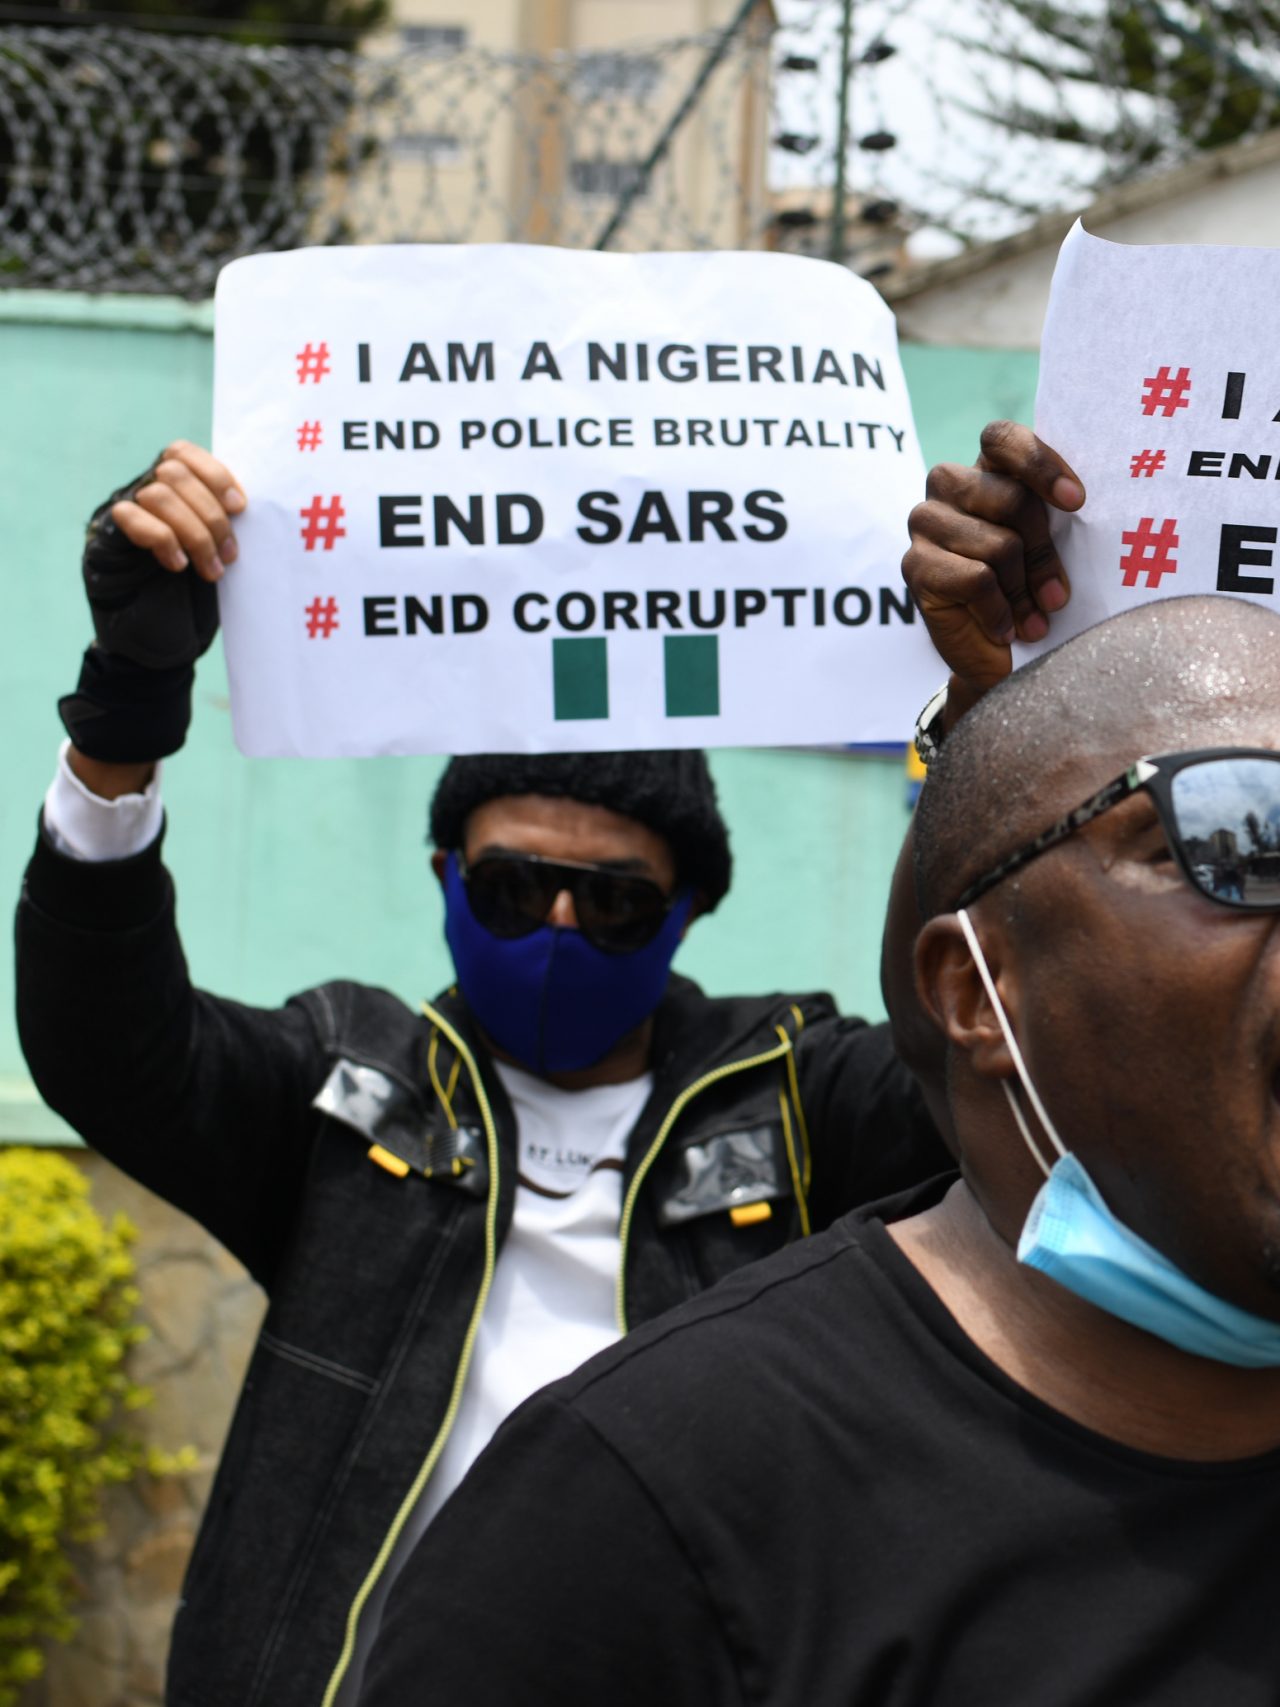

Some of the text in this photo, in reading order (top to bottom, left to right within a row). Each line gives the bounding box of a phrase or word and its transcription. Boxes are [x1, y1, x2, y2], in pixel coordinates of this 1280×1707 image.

[296, 341, 887, 392] # I AM A NIGERIAN
[1141, 366, 1192, 417] #
[1221, 371, 1246, 420] I
[296, 418, 905, 453] # END POLICE BRUTALITY
[1130, 449, 1167, 478] #
[300, 490, 788, 551] # END SARS
[1119, 517, 1180, 589] #
[305, 587, 915, 639] # END CORRUPTION
